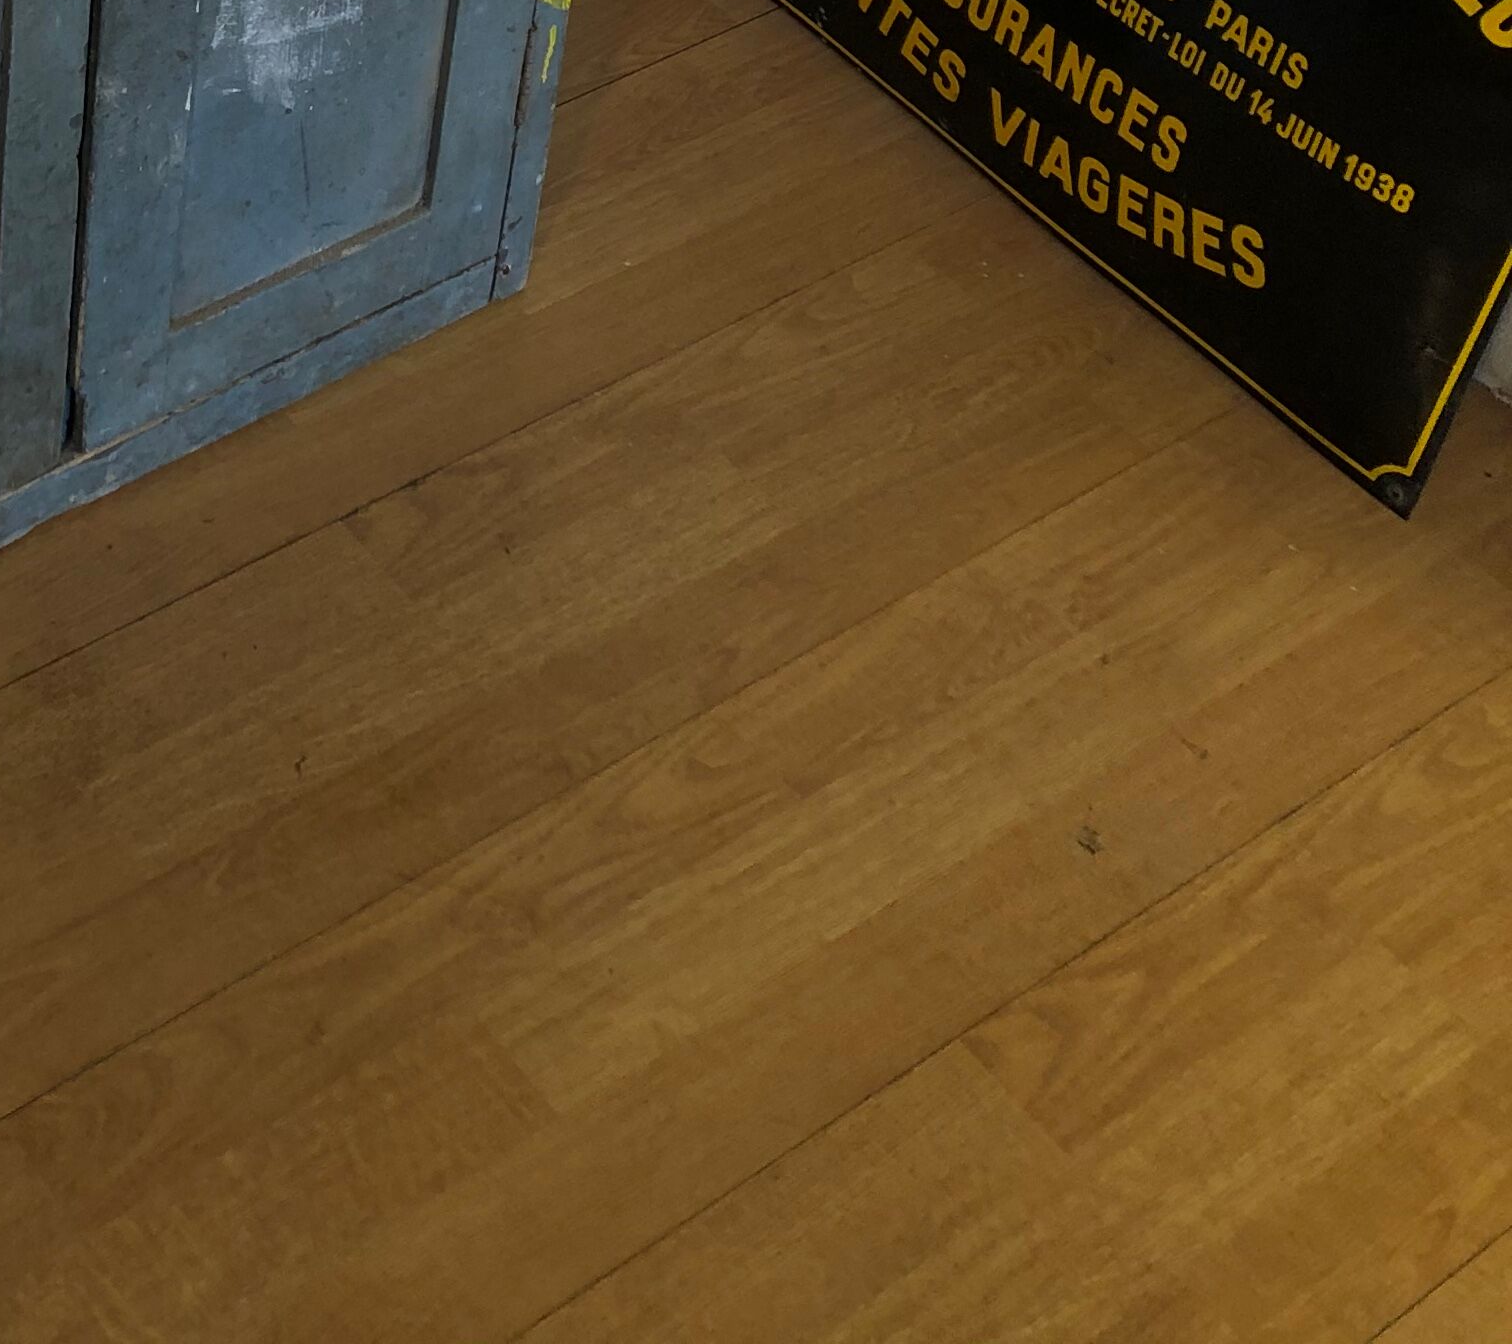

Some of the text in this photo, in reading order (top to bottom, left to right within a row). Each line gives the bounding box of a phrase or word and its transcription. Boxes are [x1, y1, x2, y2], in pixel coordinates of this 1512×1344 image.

[990, 87, 1266, 289] VIAGERES
[1209, 61, 1246, 102] DU
[1248, 89, 1275, 124] 14
[1276, 113, 1341, 170] JUIN
[1342, 154, 1415, 213] 1938
